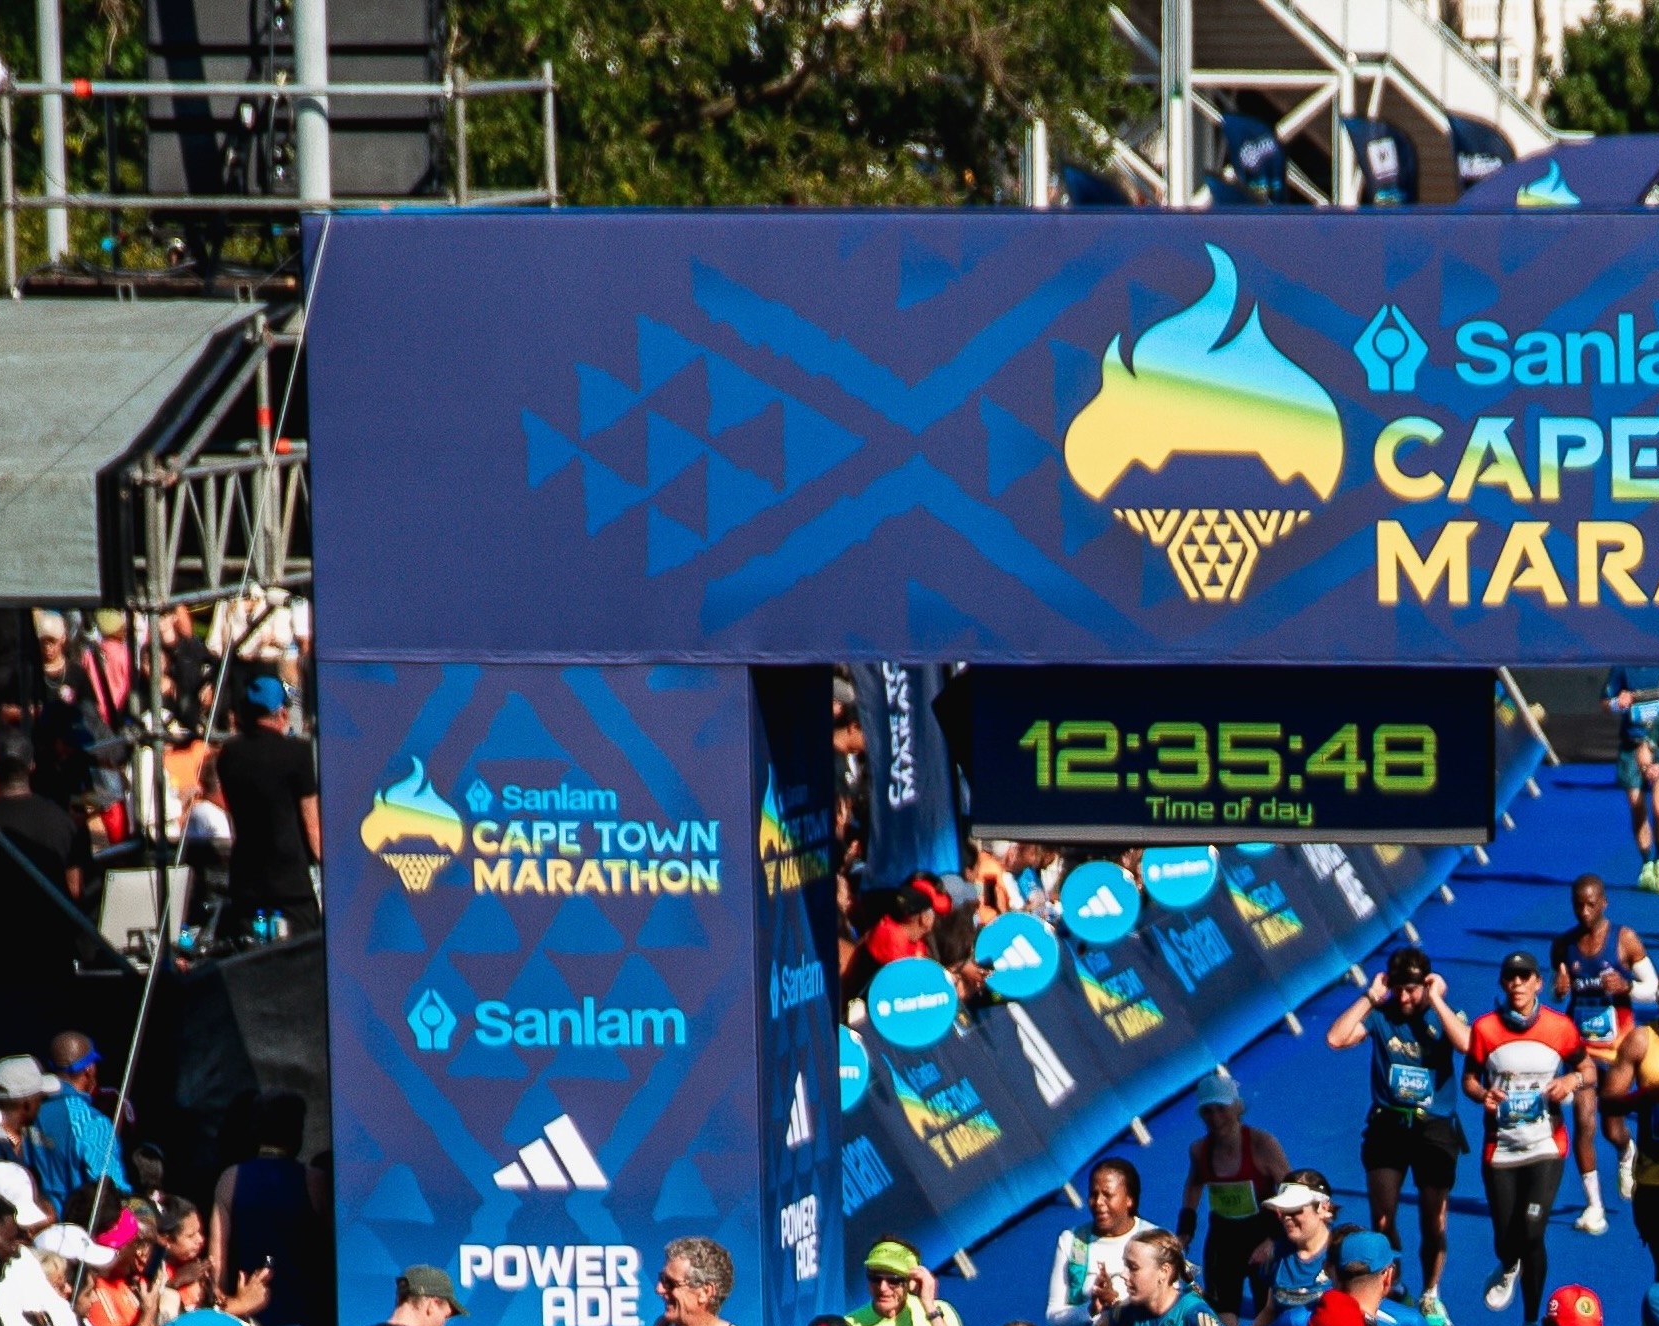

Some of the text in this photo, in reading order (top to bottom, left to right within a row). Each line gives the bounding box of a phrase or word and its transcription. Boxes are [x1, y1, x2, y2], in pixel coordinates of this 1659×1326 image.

[1020, 719, 1437, 791] 12:35:48
[502, 783, 617, 811] Sanlam
[1146, 796, 1314, 826] Time of day
[472, 819, 720, 855] CAPE TOWN
[473, 858, 720, 894] MARATHON
[781, 956, 824, 1006] Sanlam
[475, 997, 685, 1047] Sanlam
[781, 1194, 816, 1249] POWER
[460, 1245, 639, 1289] POWER
[796, 1234, 818, 1281] ADE
